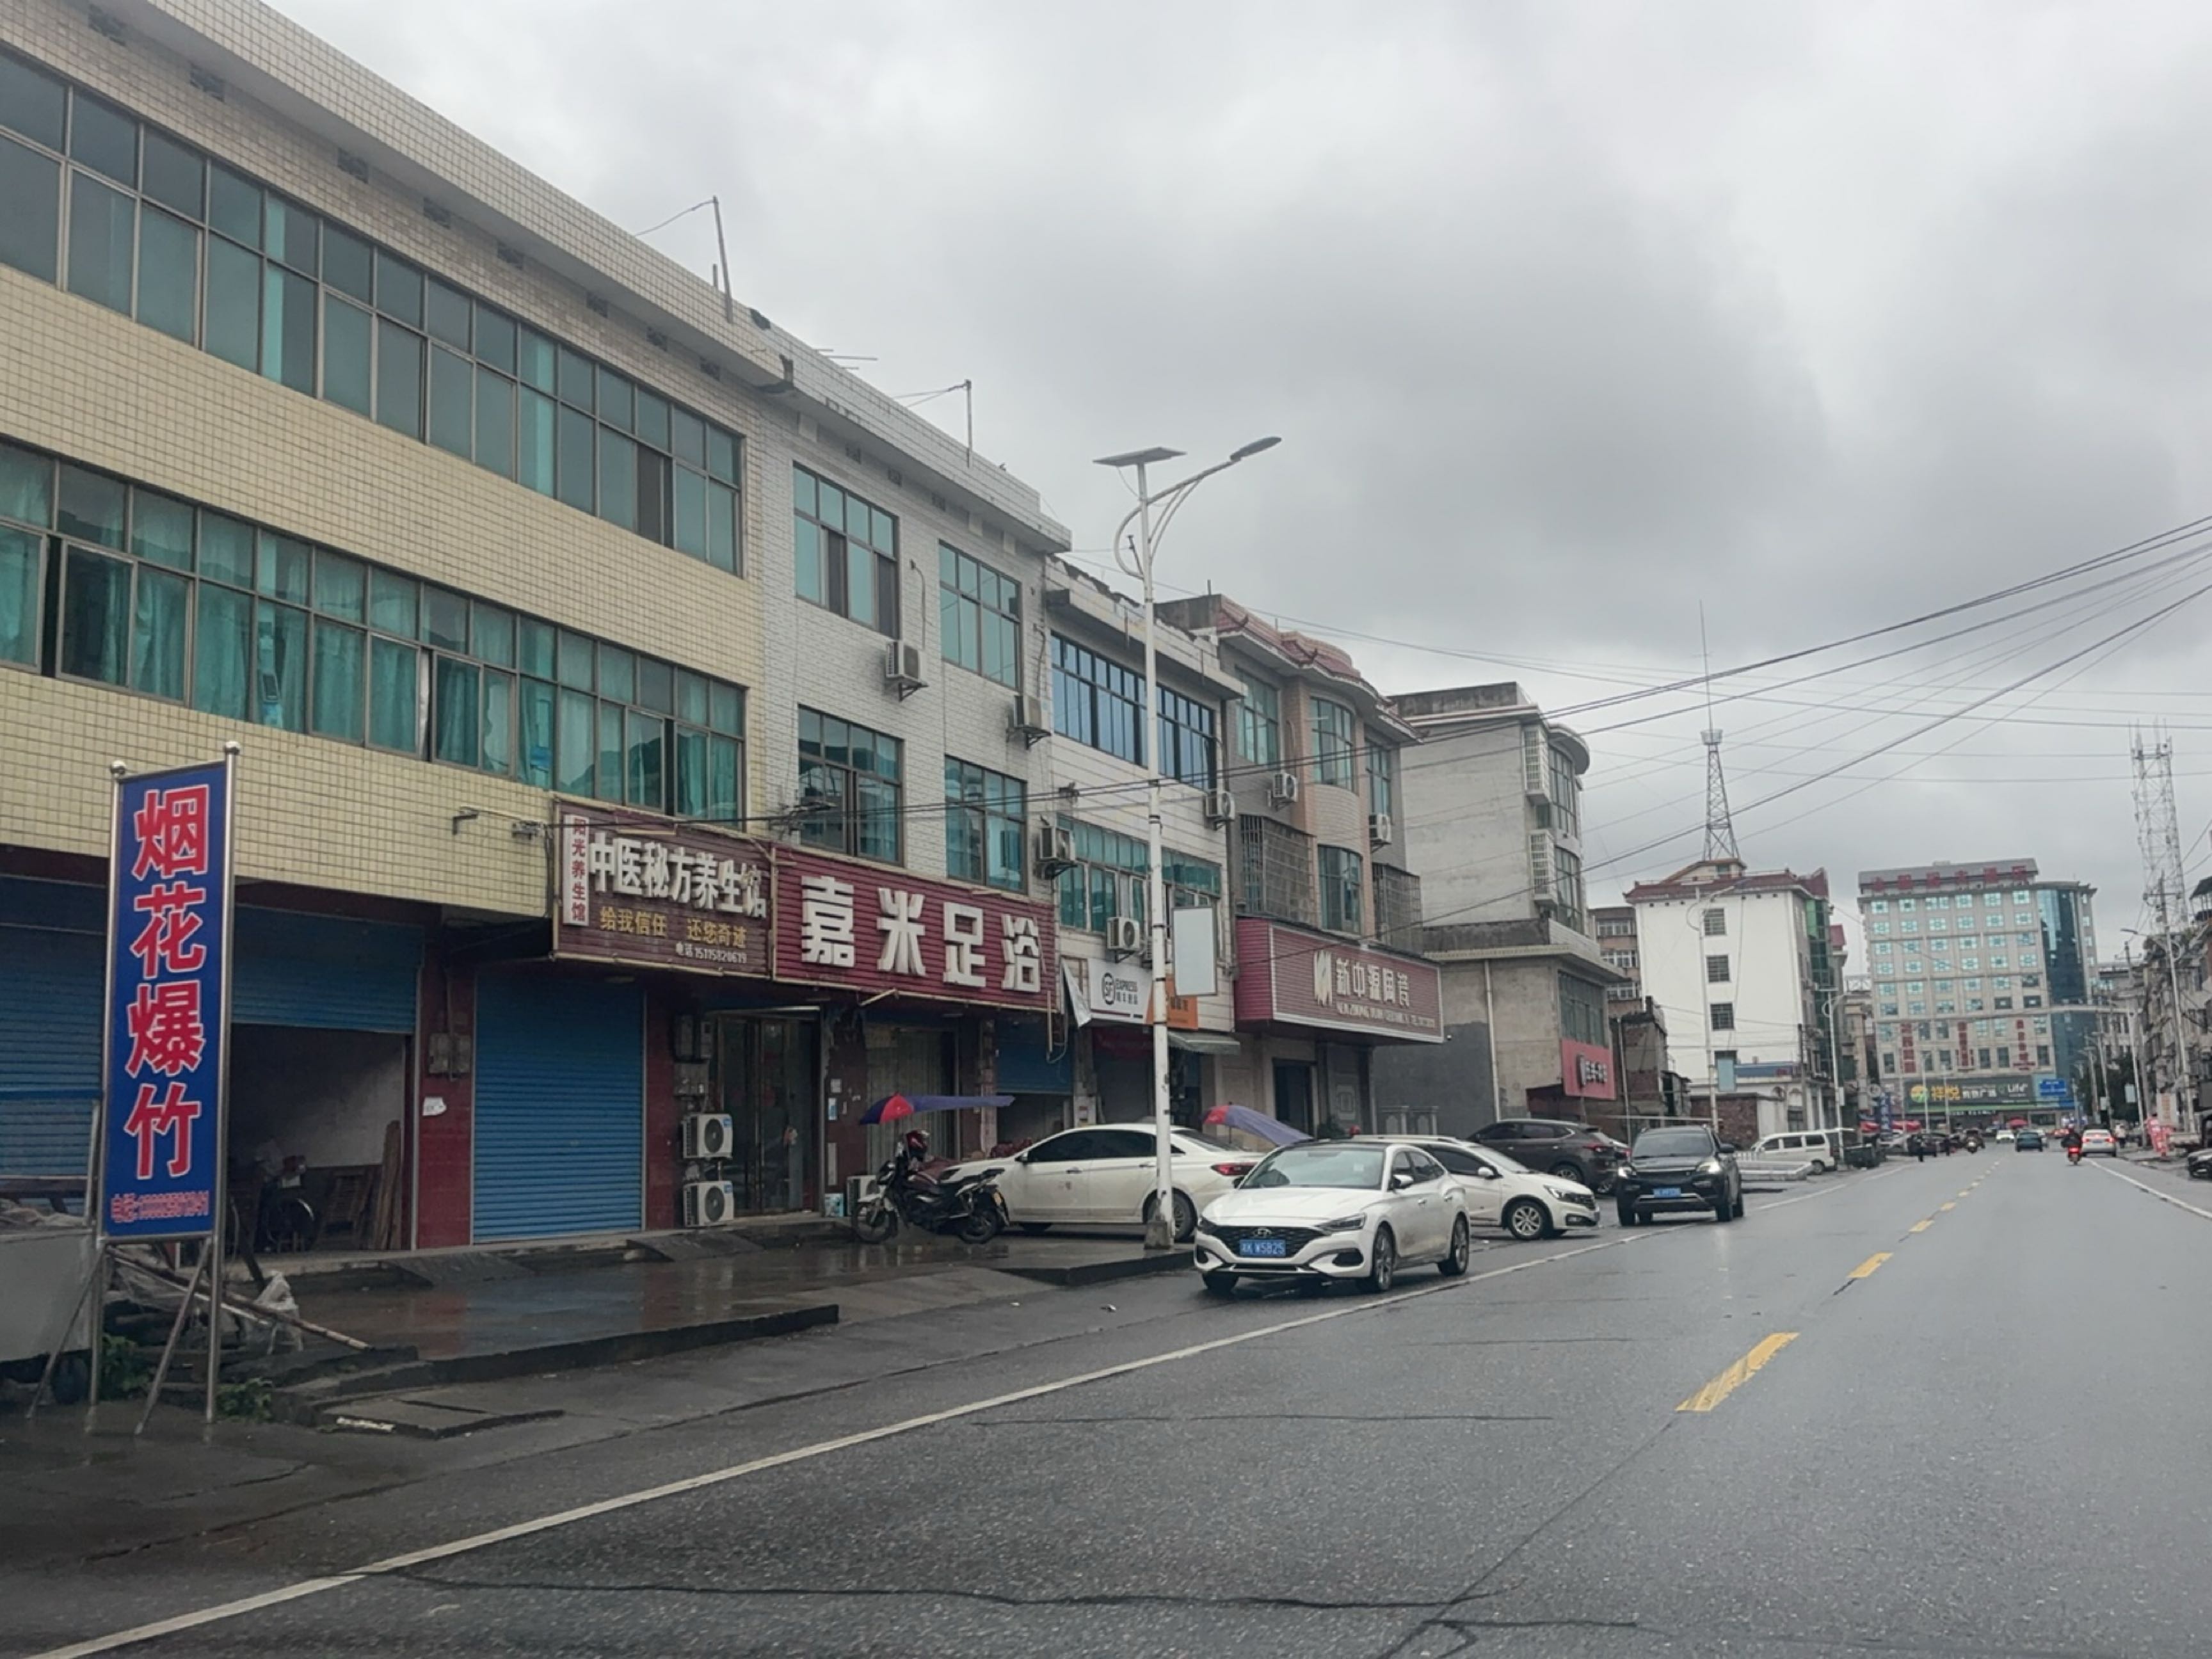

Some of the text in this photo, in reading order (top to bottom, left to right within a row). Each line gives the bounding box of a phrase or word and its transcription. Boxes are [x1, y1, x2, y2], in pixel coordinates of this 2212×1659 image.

[572, 819, 586, 922] 阳光养生馆
[589, 832, 766, 918] 中医秘方养生馆
[600, 906, 668, 938] 给我信任
[124, 784, 209, 1179] 烟花爆竹
[801, 876, 1041, 992] 嘉米足浴
